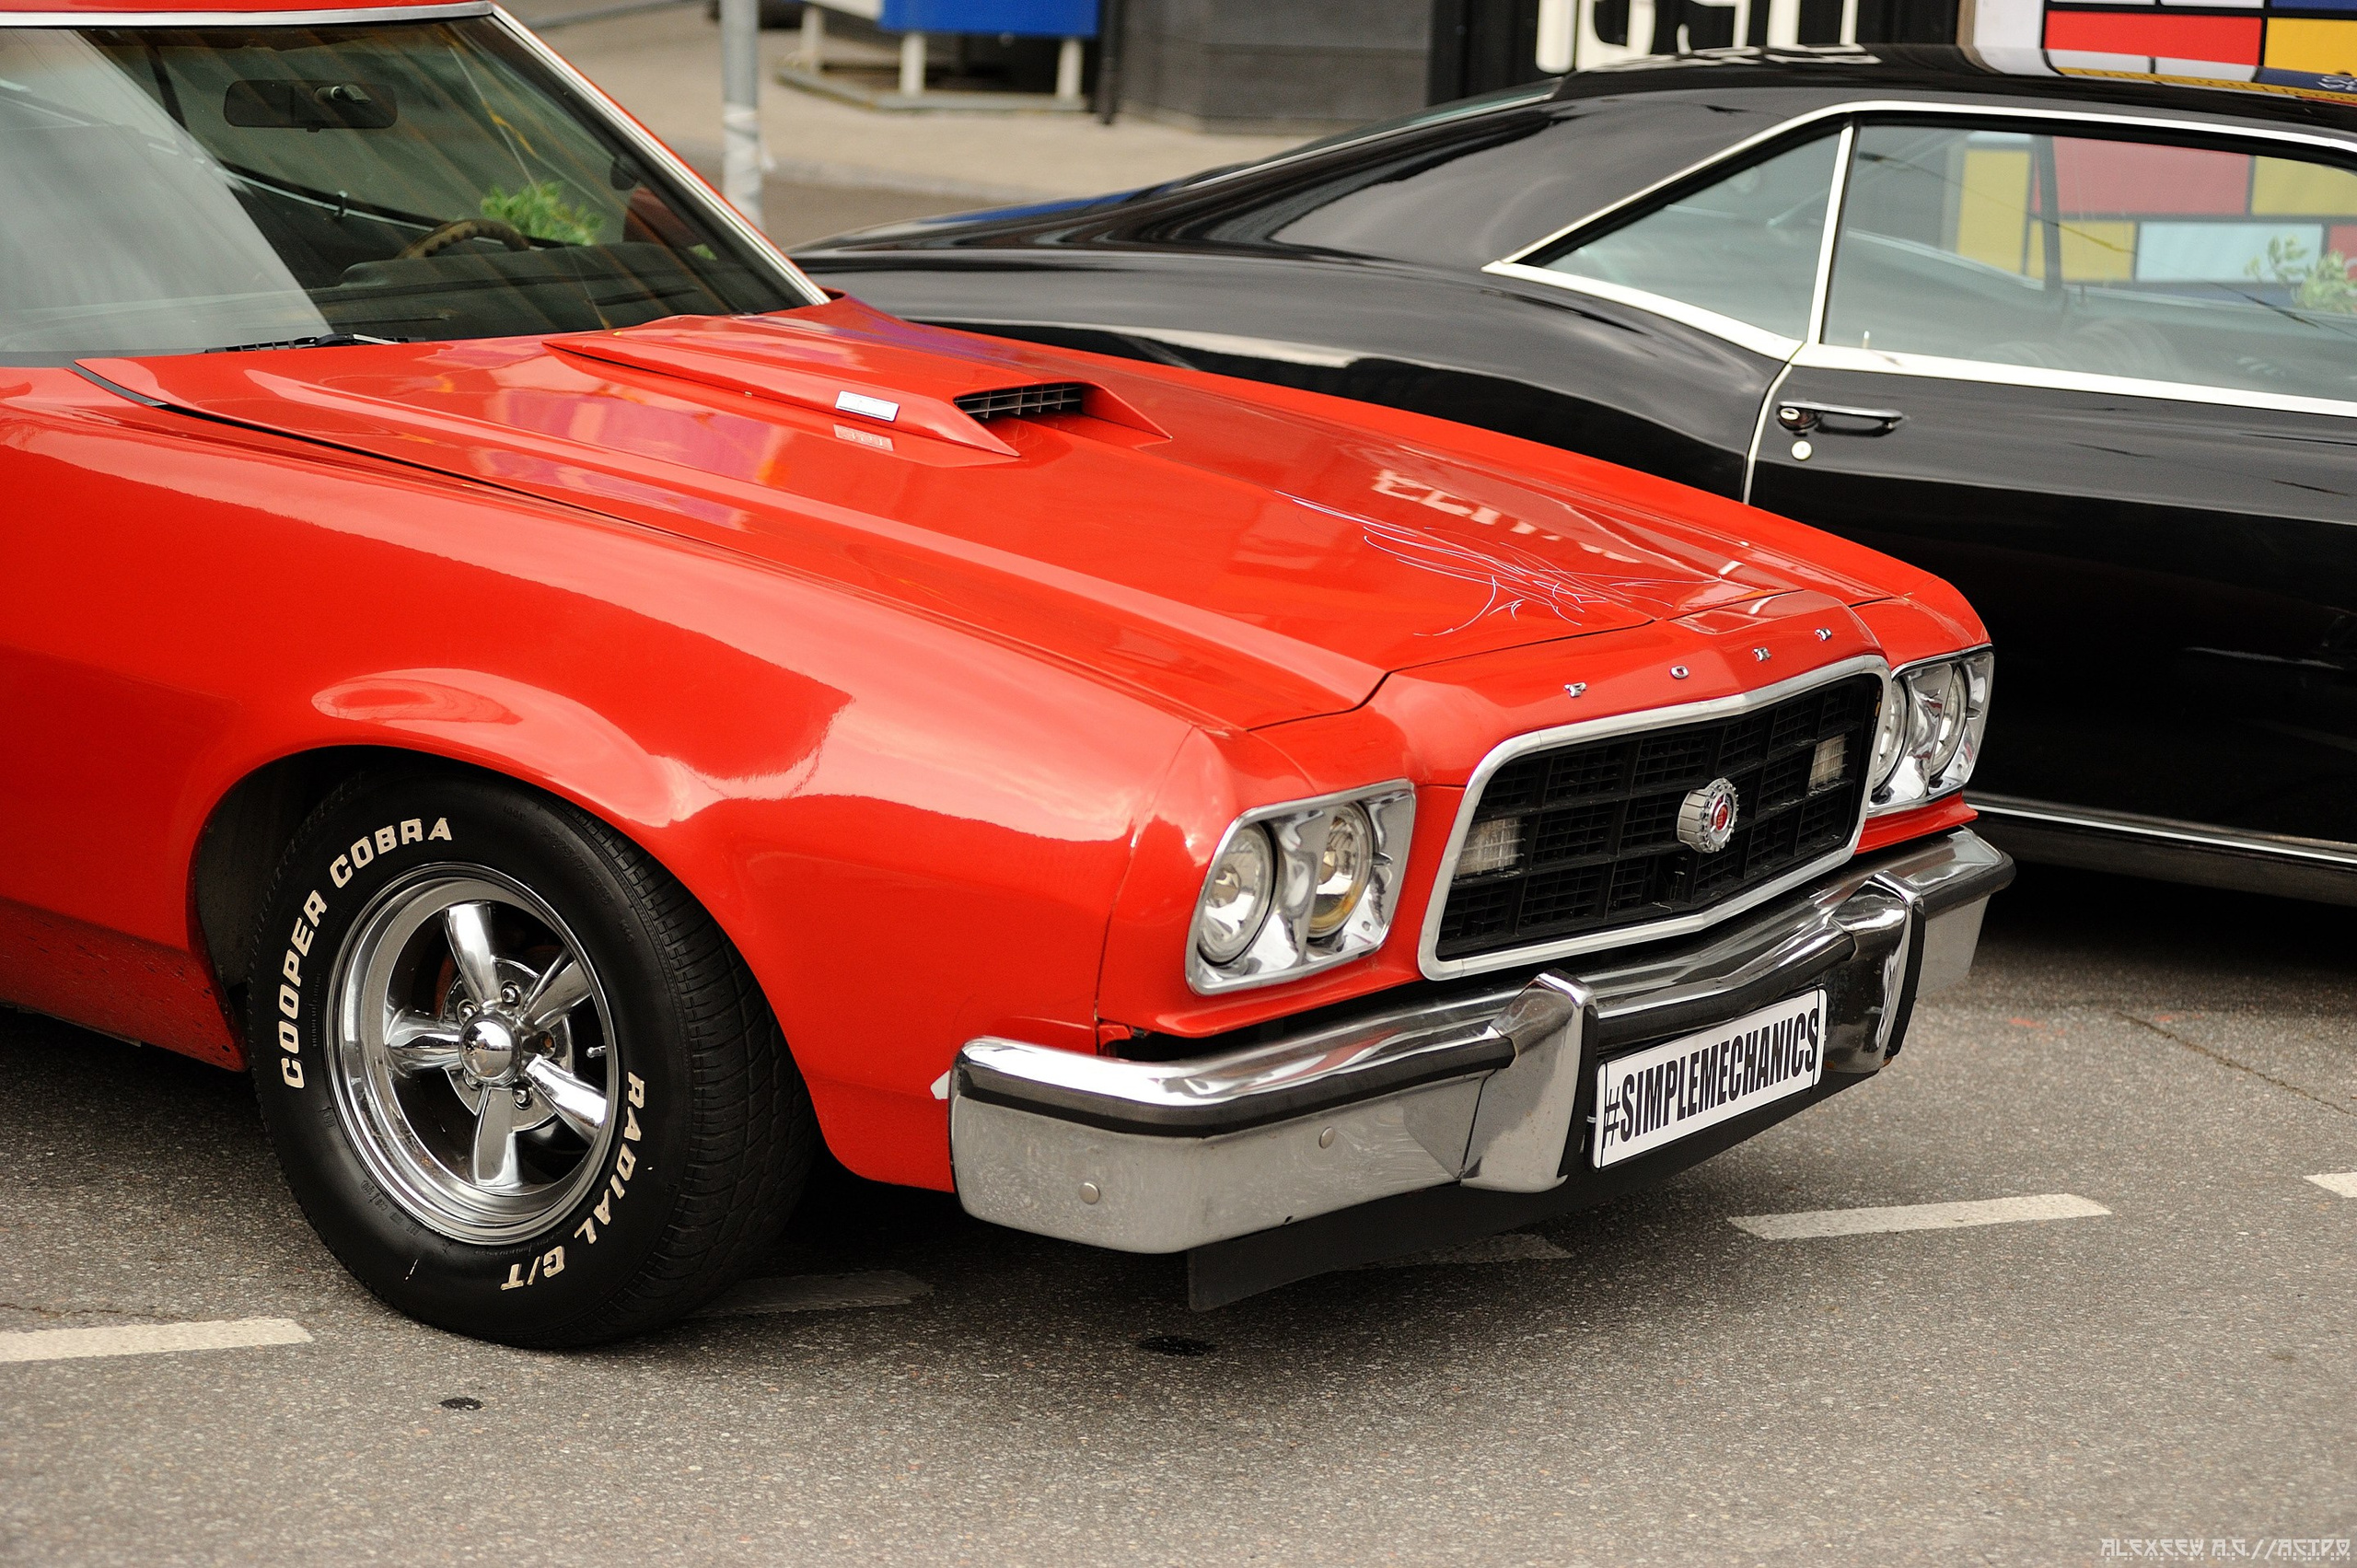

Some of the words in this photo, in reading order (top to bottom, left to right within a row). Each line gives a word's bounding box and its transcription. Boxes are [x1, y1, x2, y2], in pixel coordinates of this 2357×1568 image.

[278, 889, 327, 1089] COOPER
[329, 818, 454, 889] COBRA
[574, 1071, 645, 1244] RADIAL
[1603, 1007, 1819, 1147] #SIMPLEMECHANICS
